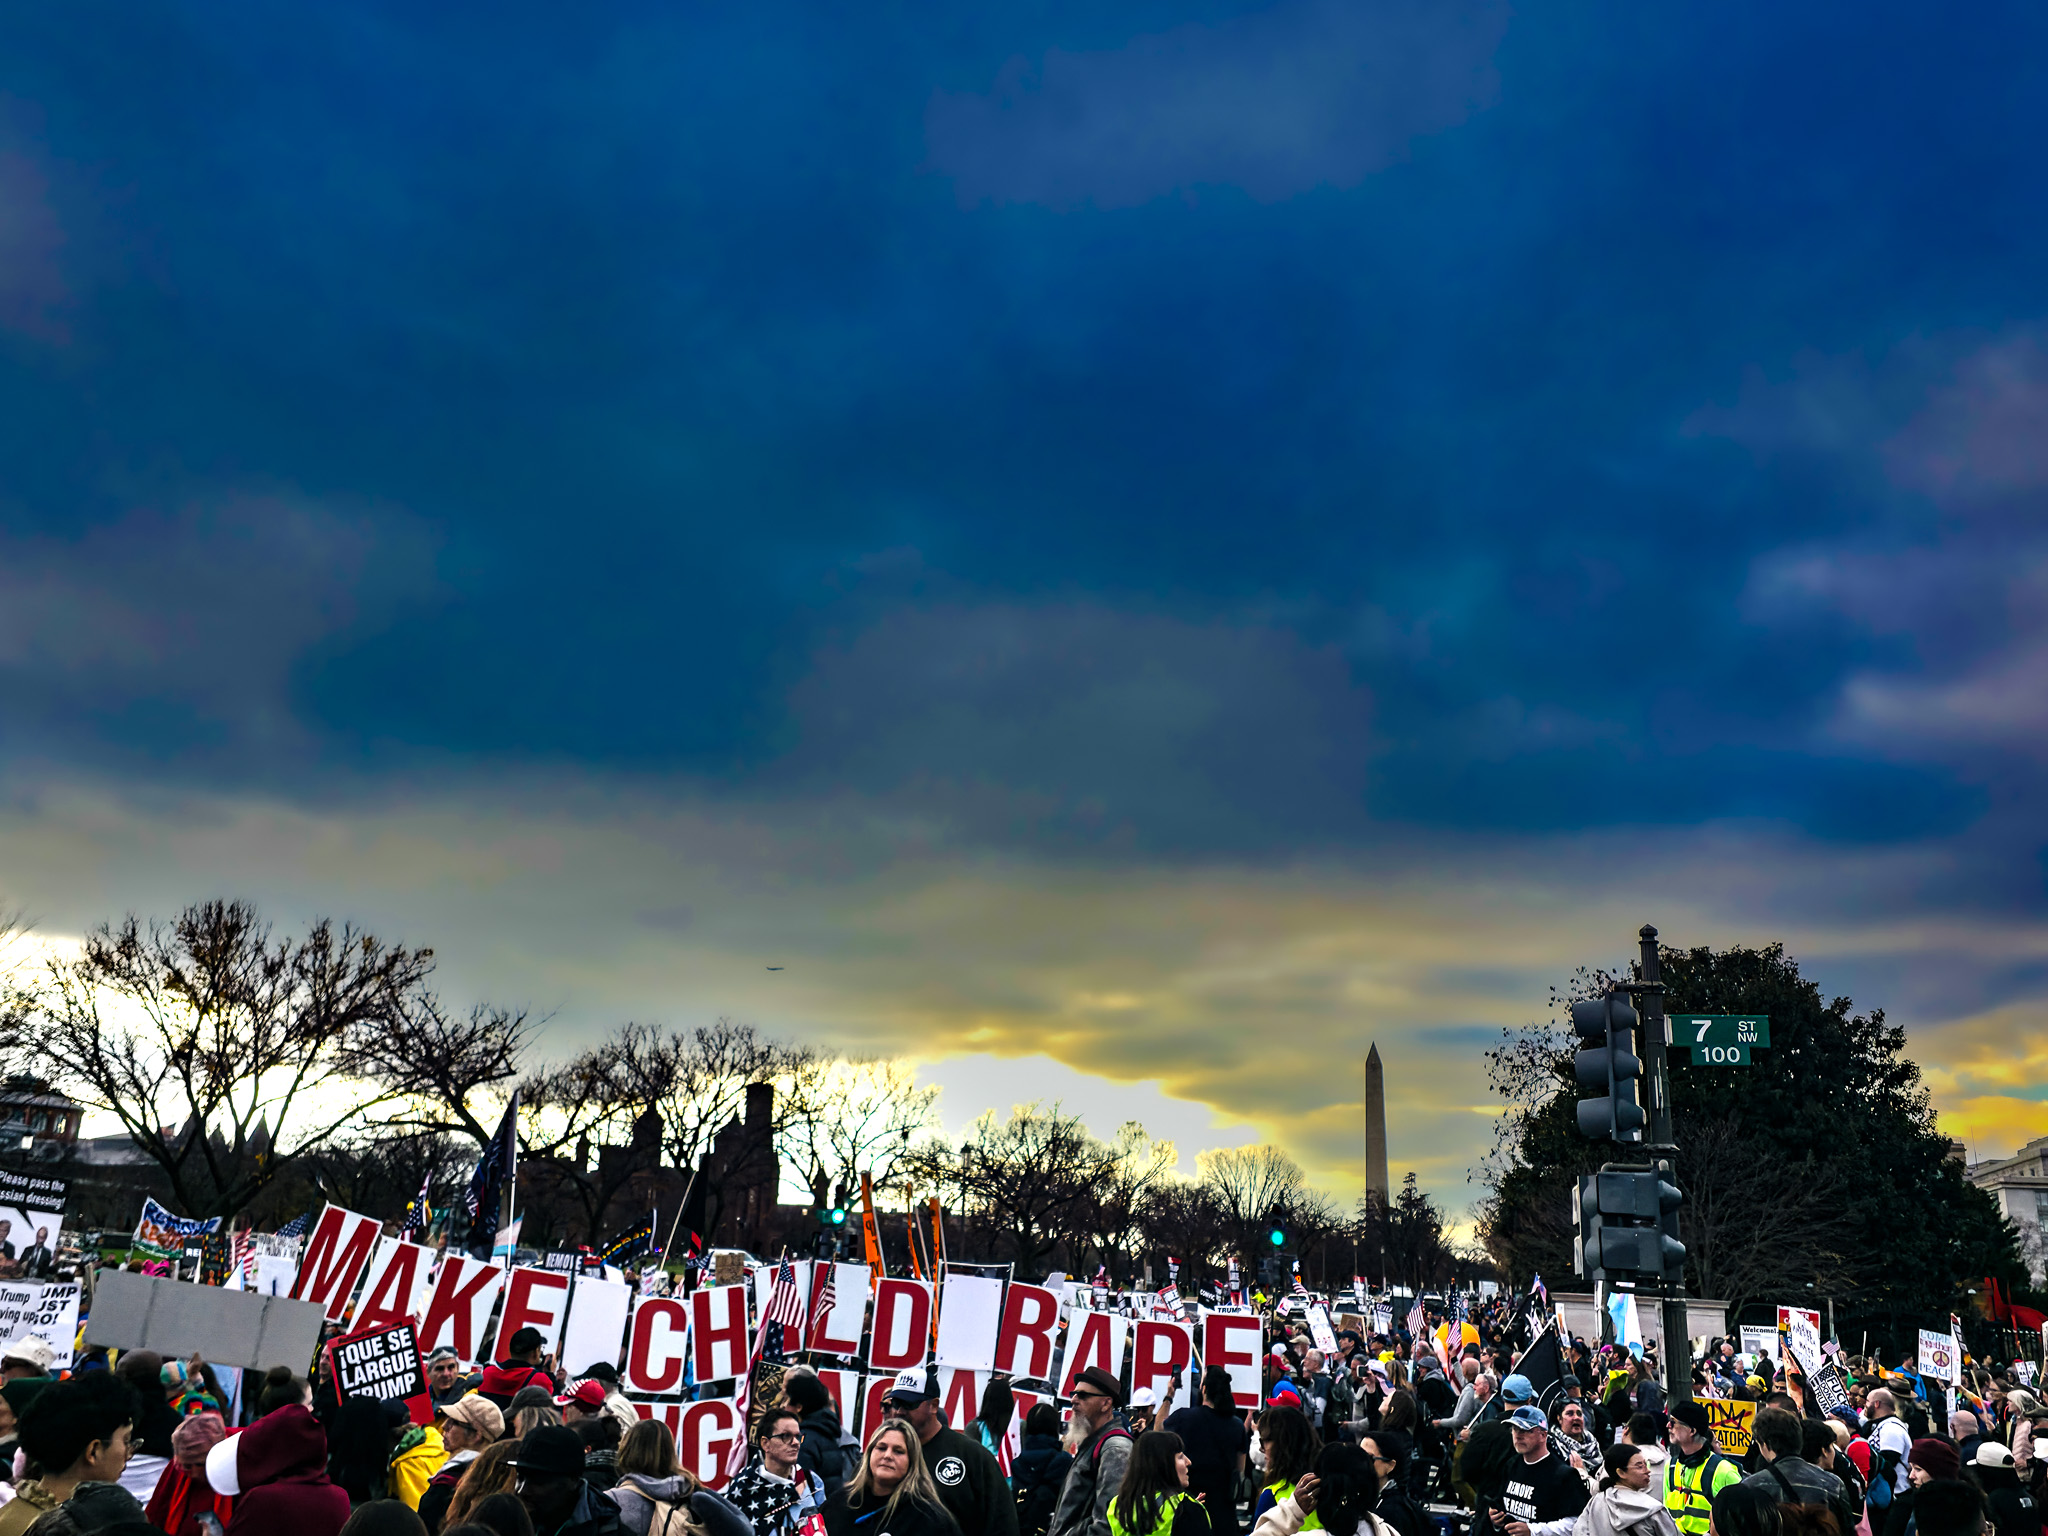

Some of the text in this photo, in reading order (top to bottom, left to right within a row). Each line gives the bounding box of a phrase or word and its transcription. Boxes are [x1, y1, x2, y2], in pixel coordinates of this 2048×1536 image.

[1691, 1019, 1757, 1042] 7 ST
[1737, 1032, 1758, 1042] NW
[1701, 1047, 1741, 1063] 100
[0, 1170, 65, 1192] Please pass the
[0, 1189, 66, 1210] ssian dressing!
[1, 1288, 31, 1306] Trump
[289, 1208, 570, 1363] MAKE
[996, 1282, 1259, 1407] RAPE
[339, 1336, 385, 1369] ¡QUE
[387, 1327, 412, 1352] SE
[341, 1349, 417, 1390] LARGUE
[1920, 1363, 1951, 1378] PEACE
[1827, 1376, 1848, 1407] FUCK
[1711, 1429, 1752, 1448] ATORS
[1506, 1480, 1535, 1500] REMOVE
[1510, 1499, 1537, 1519] REGIME
